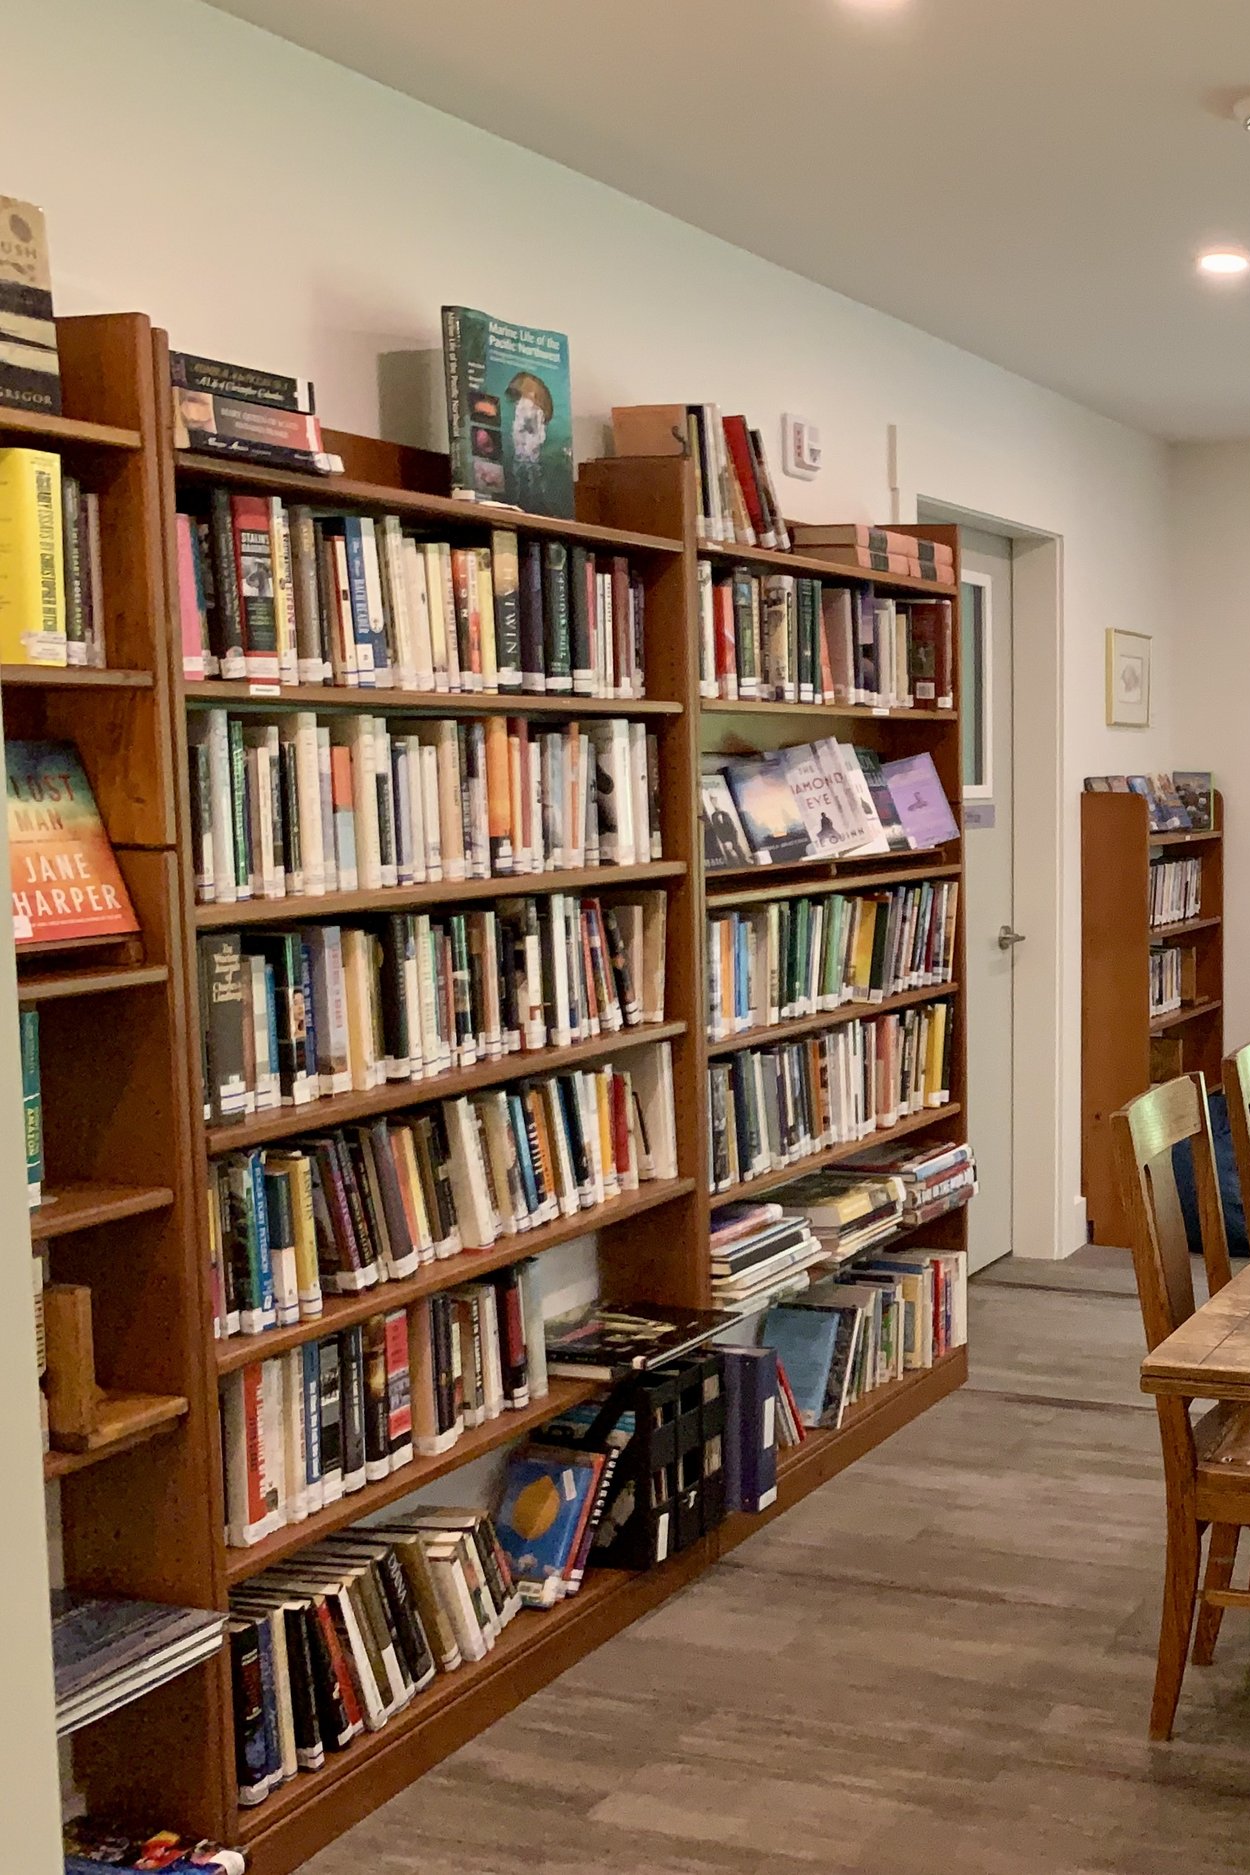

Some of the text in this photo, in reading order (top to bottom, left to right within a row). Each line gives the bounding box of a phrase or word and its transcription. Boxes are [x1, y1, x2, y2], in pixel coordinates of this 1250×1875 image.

[488, 322, 560, 351] Marine Life of the
[488, 334, 517, 352] Pacific
[518, 342, 561, 364] Northwest
[40, 553, 57, 606] CHRISTOPHER
[790, 772, 845, 796] IAMOND
[798, 765, 815, 776] THE
[10, 774, 75, 803] LOST
[806, 793, 832, 810] EYE
[14, 808, 64, 833] MAN
[828, 828, 865, 845] QUINN
[25, 852, 92, 884] JANE
[12, 884, 123, 920] HARPER
[255, 1166, 269, 1274] ROGER TORY PETERSON
